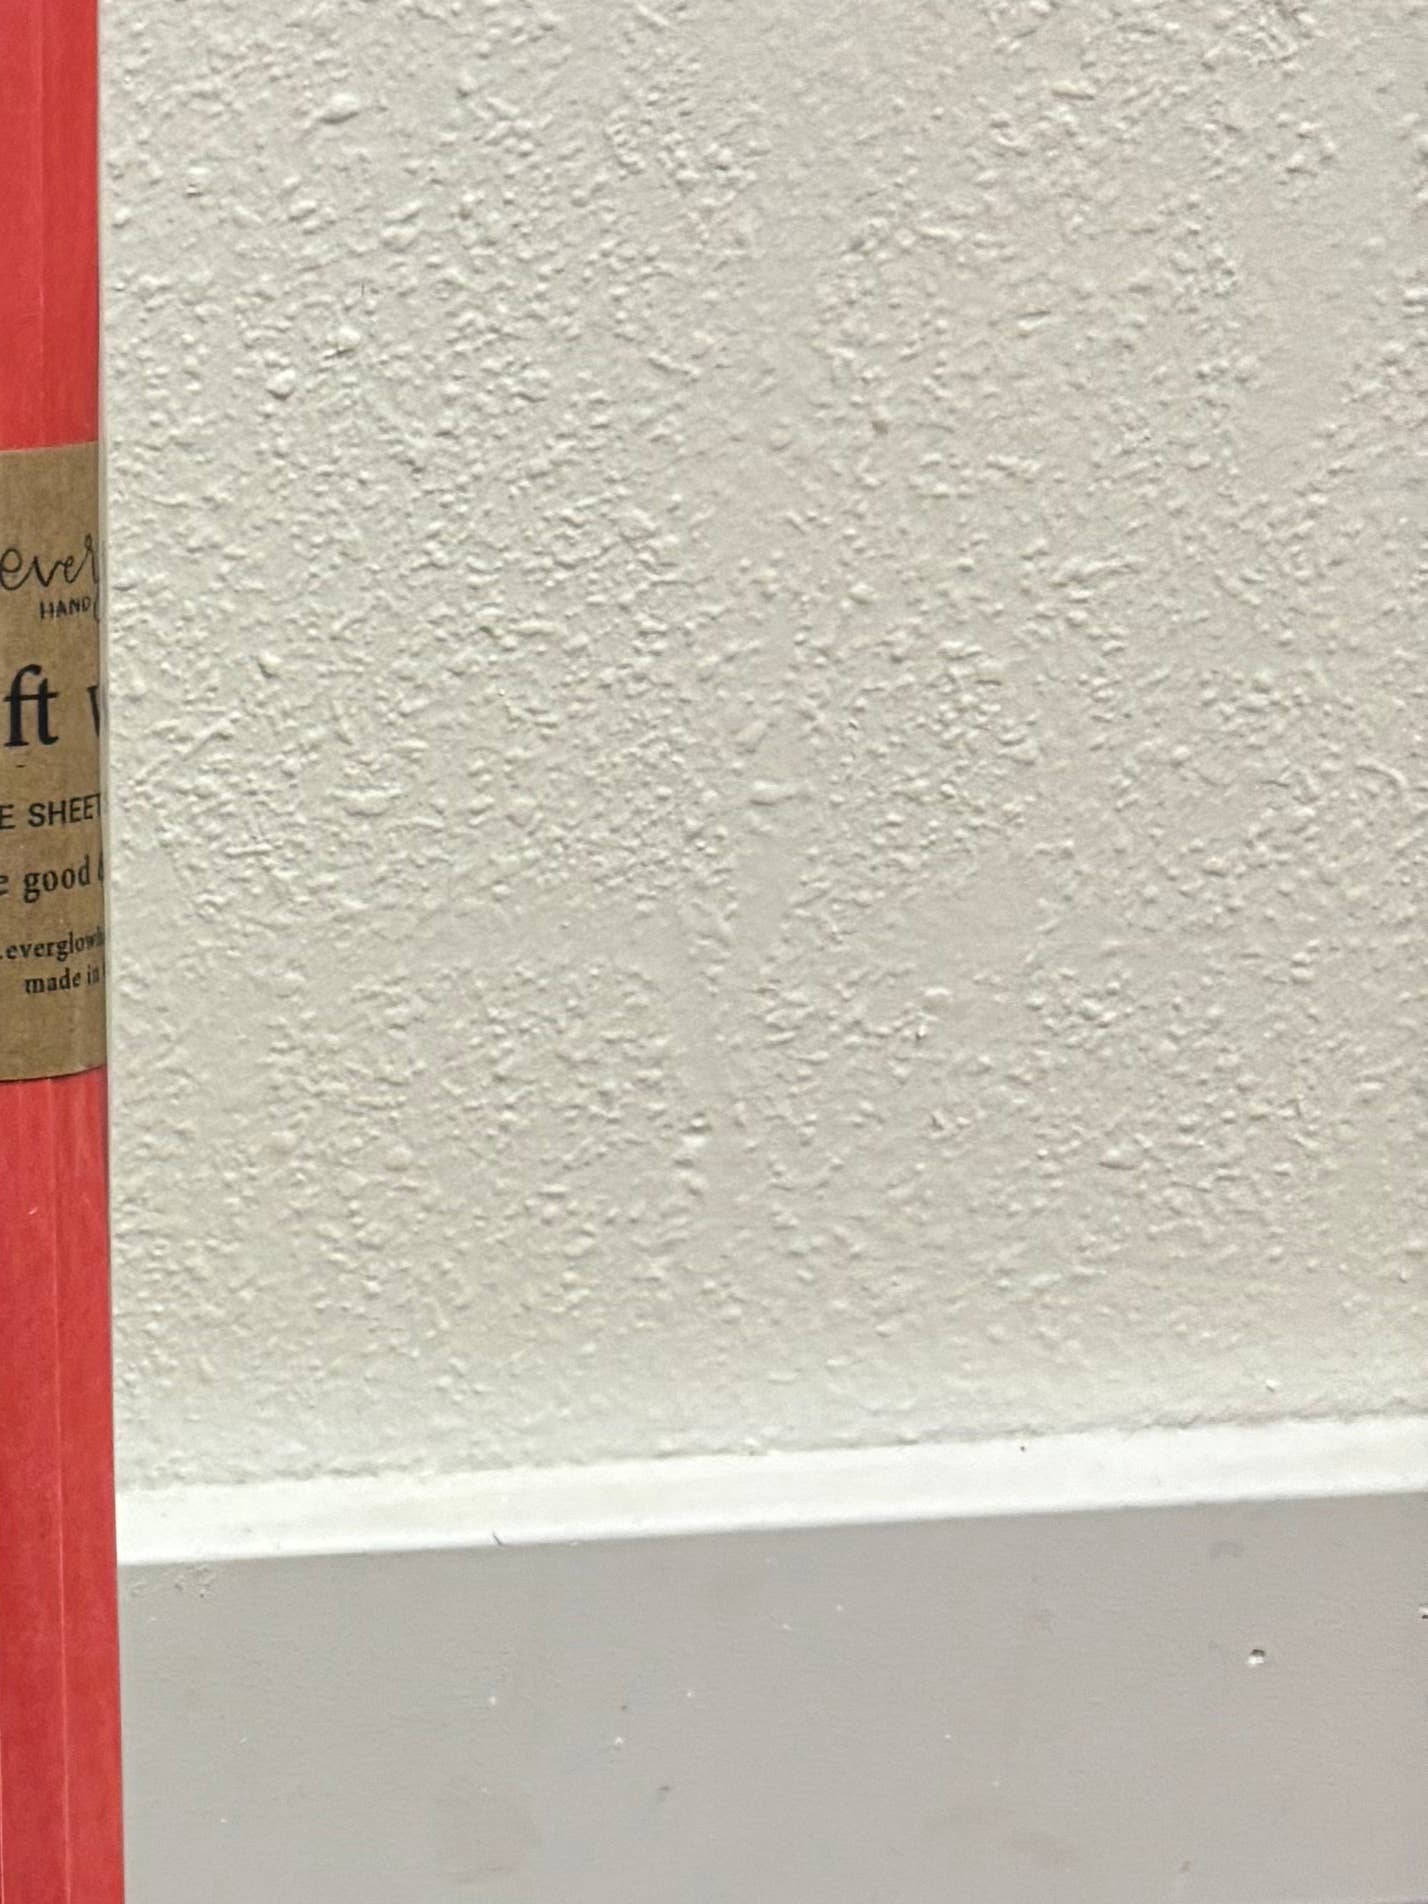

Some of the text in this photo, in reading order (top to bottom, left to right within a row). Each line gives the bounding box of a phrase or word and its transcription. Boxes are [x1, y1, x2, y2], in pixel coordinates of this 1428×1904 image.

[40, 596, 92, 620] HAND
[23, 854, 90, 903] good
[25, 968, 81, 994] made
